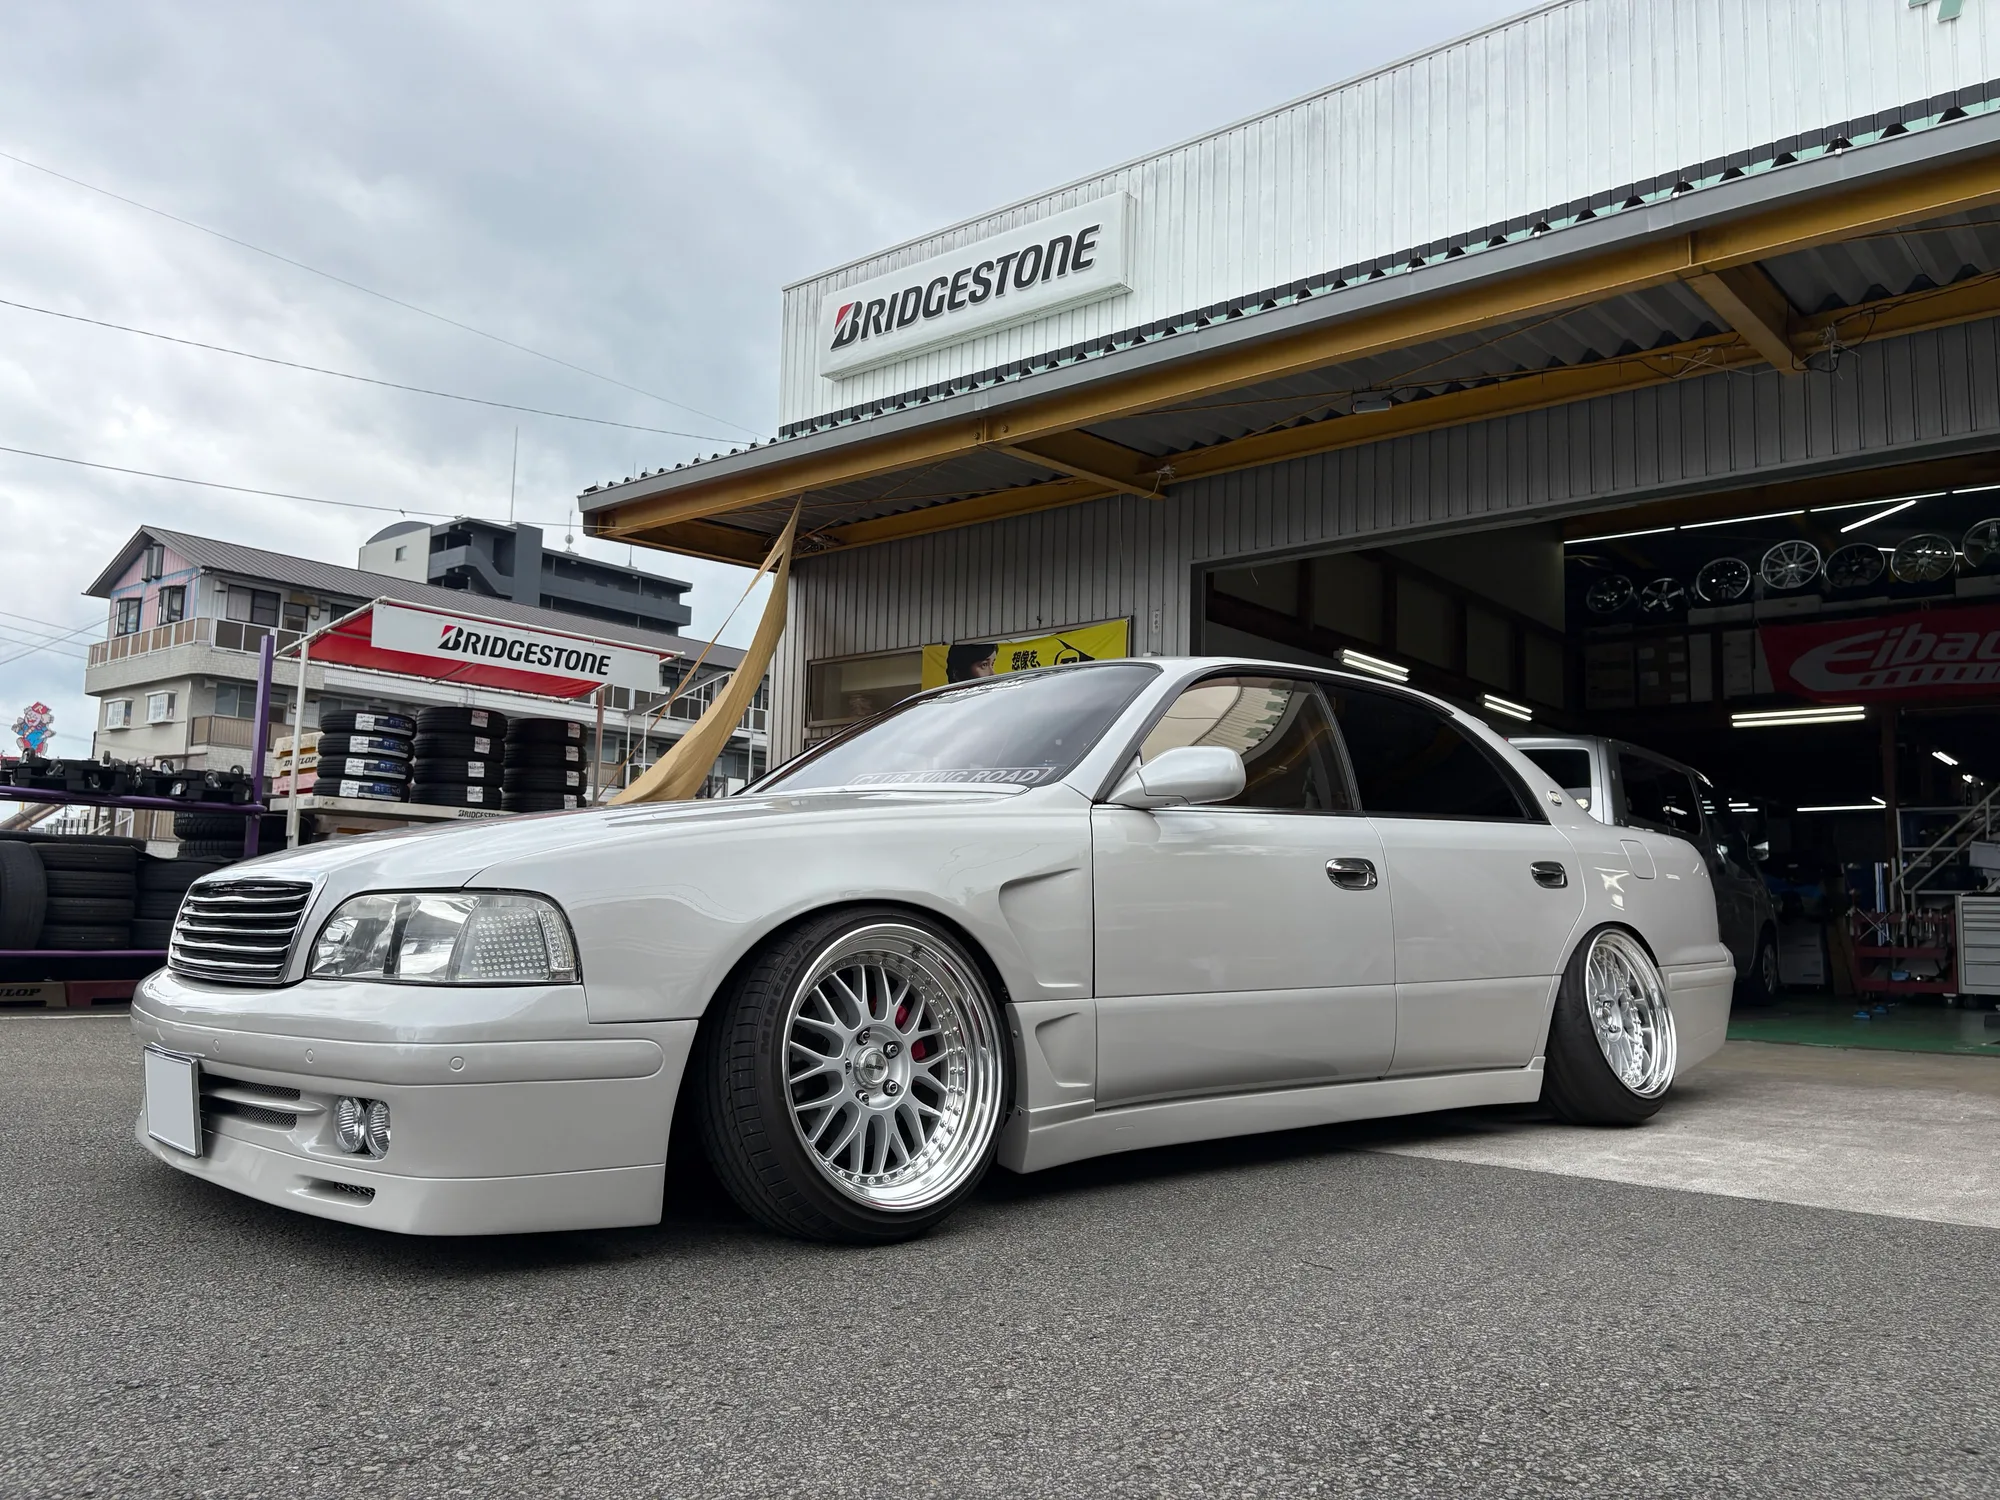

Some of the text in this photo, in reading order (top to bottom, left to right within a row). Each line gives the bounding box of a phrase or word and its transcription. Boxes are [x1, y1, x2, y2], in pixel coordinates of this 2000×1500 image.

[830, 223, 1103, 351] BRIDGESTONE
[437, 624, 611, 676] BRIDGESTONE
[284, 756, 317, 767] DLOP
[912, 770, 968, 784] KING
[968, 769, 1040, 783] ROAD
[760, 938, 815, 1055] MINERVA
